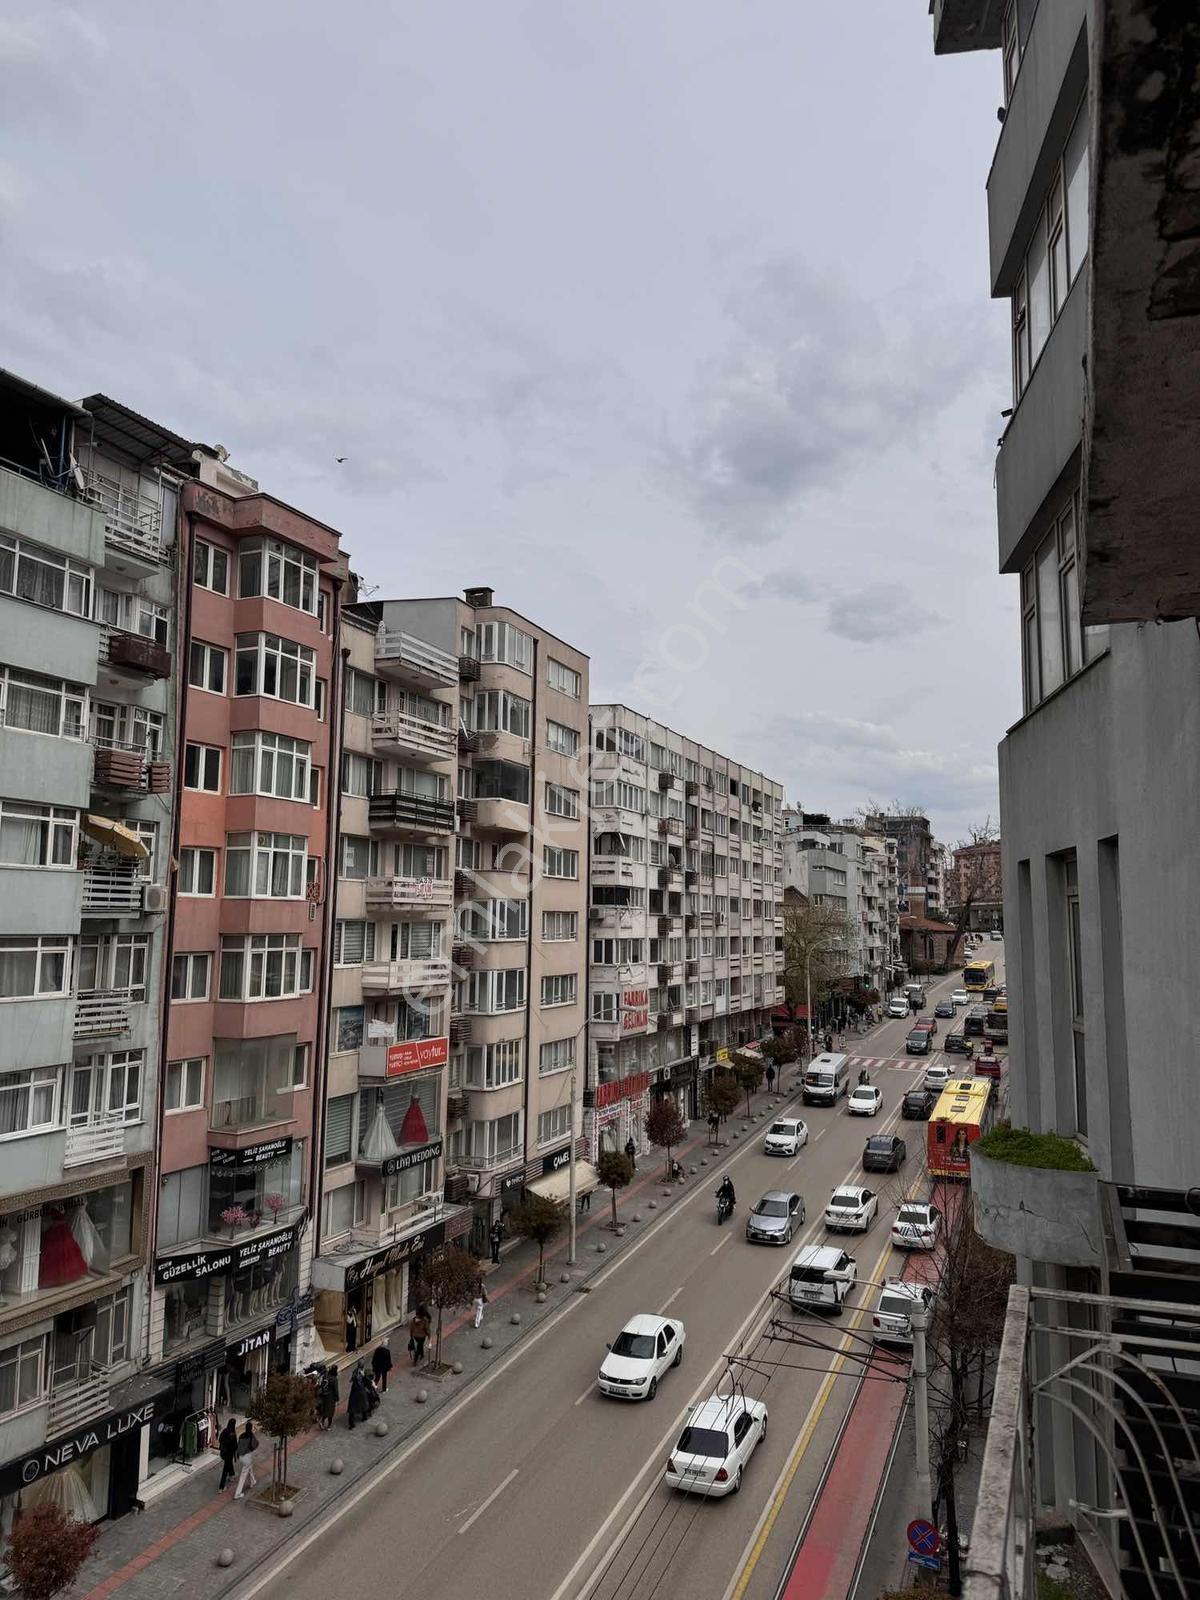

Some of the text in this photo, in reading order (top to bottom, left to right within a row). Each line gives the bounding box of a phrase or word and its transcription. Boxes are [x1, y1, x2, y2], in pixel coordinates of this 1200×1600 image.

[255, 1151, 274, 1161] BEAUTY
[411, 1145, 440, 1164] WEDDING
[239, 1231, 293, 1258] YELİZ ŞAHANOĞLU
[267, 1242, 292, 1257] BEAUTY
[163, 1255, 206, 1280] GÜZELLİK
[195, 1255, 231, 1278] SALONU
[237, 1331, 270, 1356] JİTAN
[44, 1402, 155, 1471] NEVA LUXE
